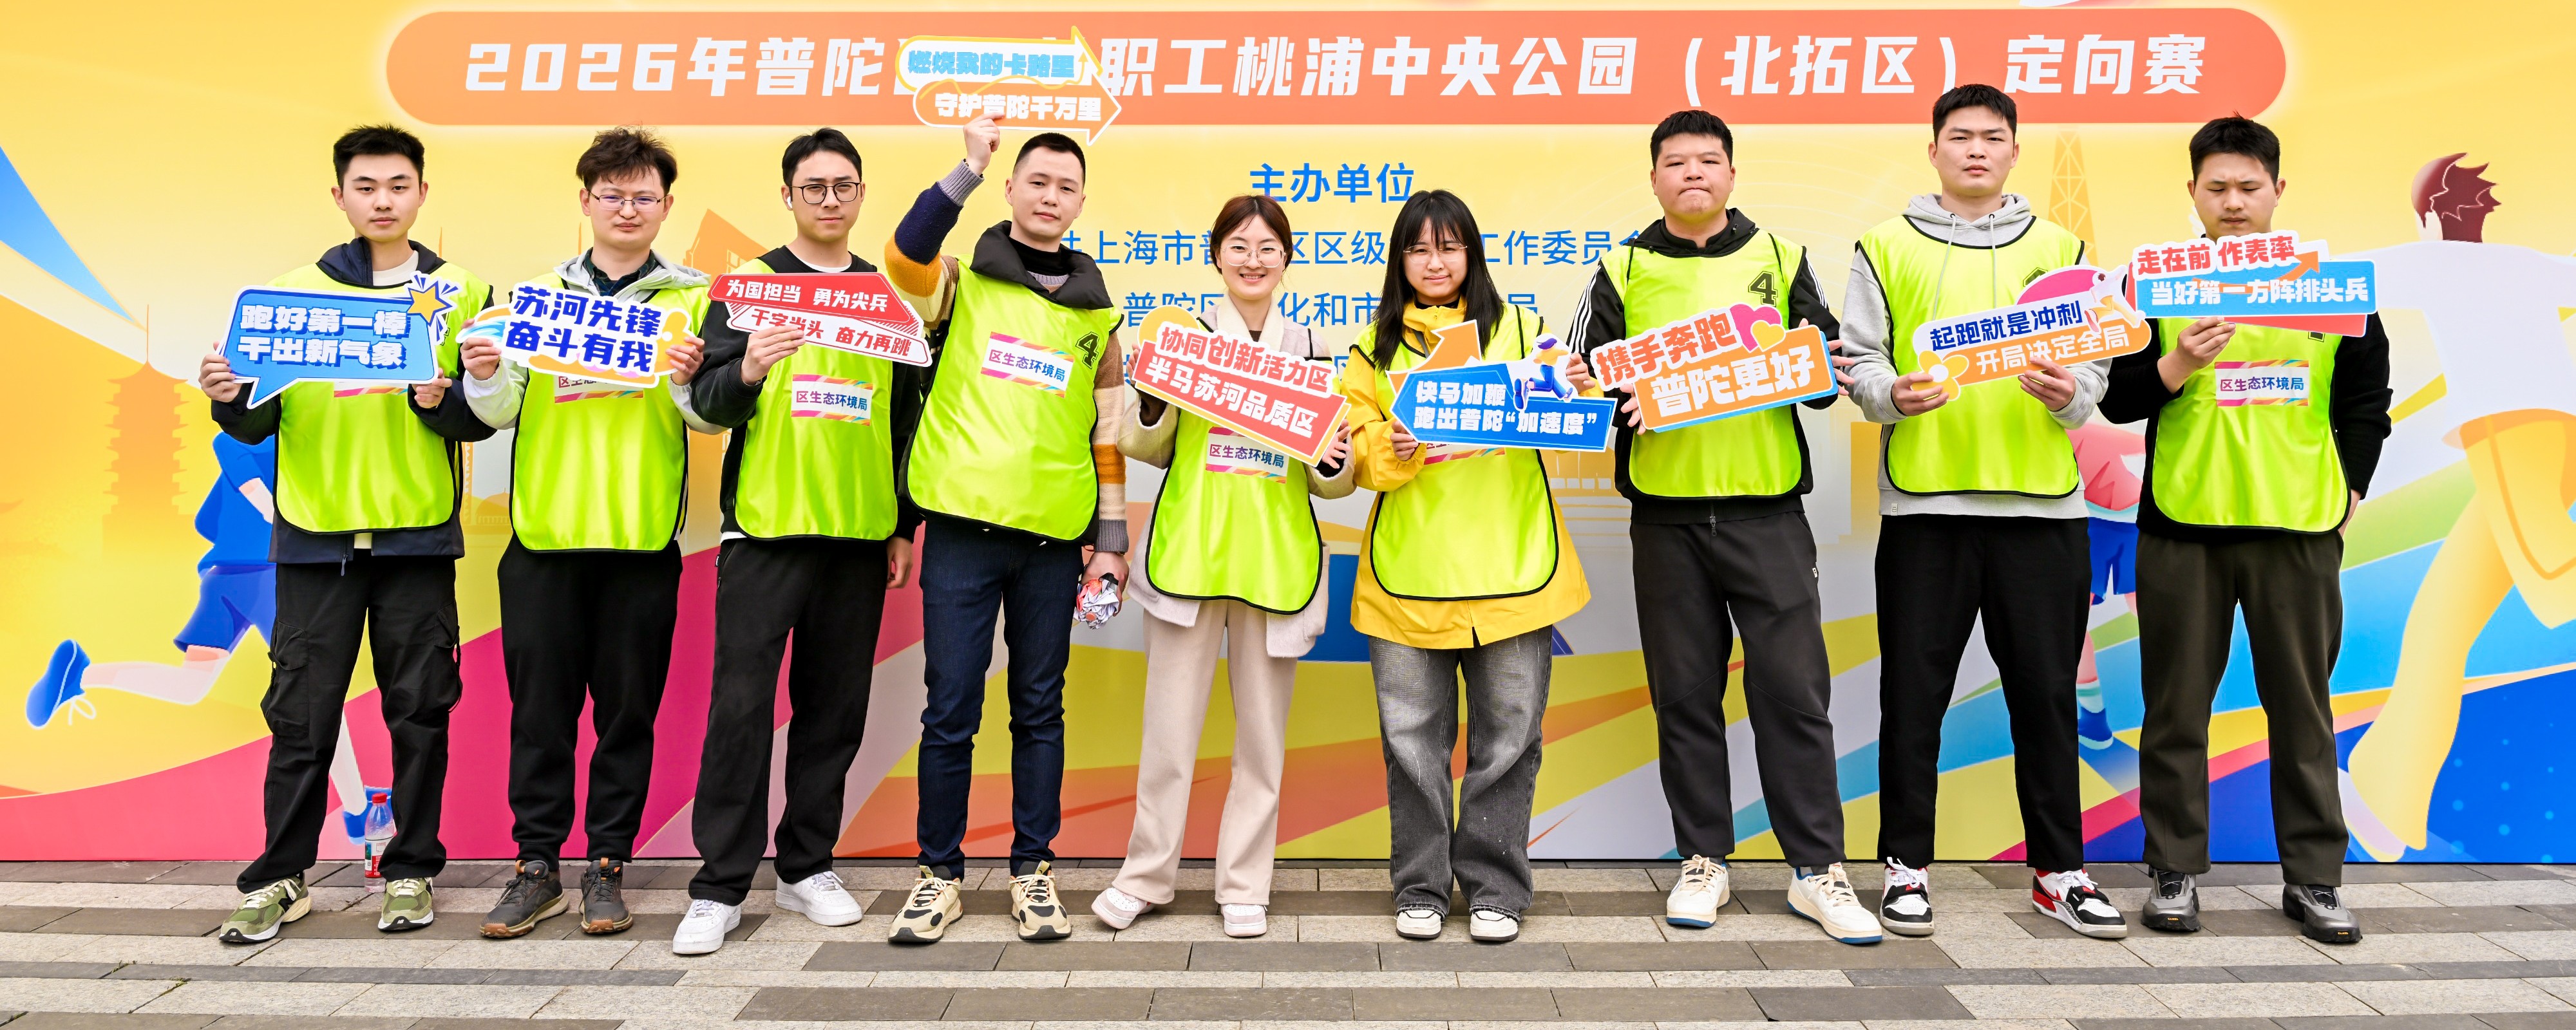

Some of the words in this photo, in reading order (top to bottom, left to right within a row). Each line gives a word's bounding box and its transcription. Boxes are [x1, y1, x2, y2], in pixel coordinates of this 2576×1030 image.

[465, 33, 2206, 107] 2026年普陀职工桃浦中央公园（北拓区）定向赛
[908, 50, 1075, 78] 燃烧我的卡路里
[1250, 162, 1414, 203] 主办单位
[2137, 243, 2211, 276] 走在前
[2218, 235, 2295, 268] 作表率
[727, 279, 801, 304] 为国担当
[812, 288, 889, 313] 勇为尖兵
[1748, 270, 1779, 306] 4
[2151, 276, 2369, 306] 当好第一方阵排头兵
[240, 304, 410, 339] 跑好第一棒
[513, 286, 661, 338] 苏河先锋
[1929, 300, 2083, 351] 起跑就是冲刺
[237, 335, 406, 368] 干出新气象
[505, 320, 653, 373] 奋斗有我
[835, 326, 912, 357] 奋力再跳
[1075, 332, 1100, 369] 4
[1160, 326, 1332, 392] 协同创新活力区
[1596, 312, 1738, 386] 携手奔跑
[1976, 324, 2130, 375] 开局决定全局
[989, 349, 1066, 382] 区生态环境局
[1651, 344, 1815, 418] 普陀更好
[796, 390, 867, 411] 区生态环境局
[1145, 356, 1319, 438] 半马苏河品质区
[1416, 381, 1506, 407] 快马加鞭
[2220, 377, 2304, 391] 区生态环境局
[1414, 406, 1597, 435] 跑出普陀“加速度”
[1209, 444, 1284, 469] 区生态环境局
